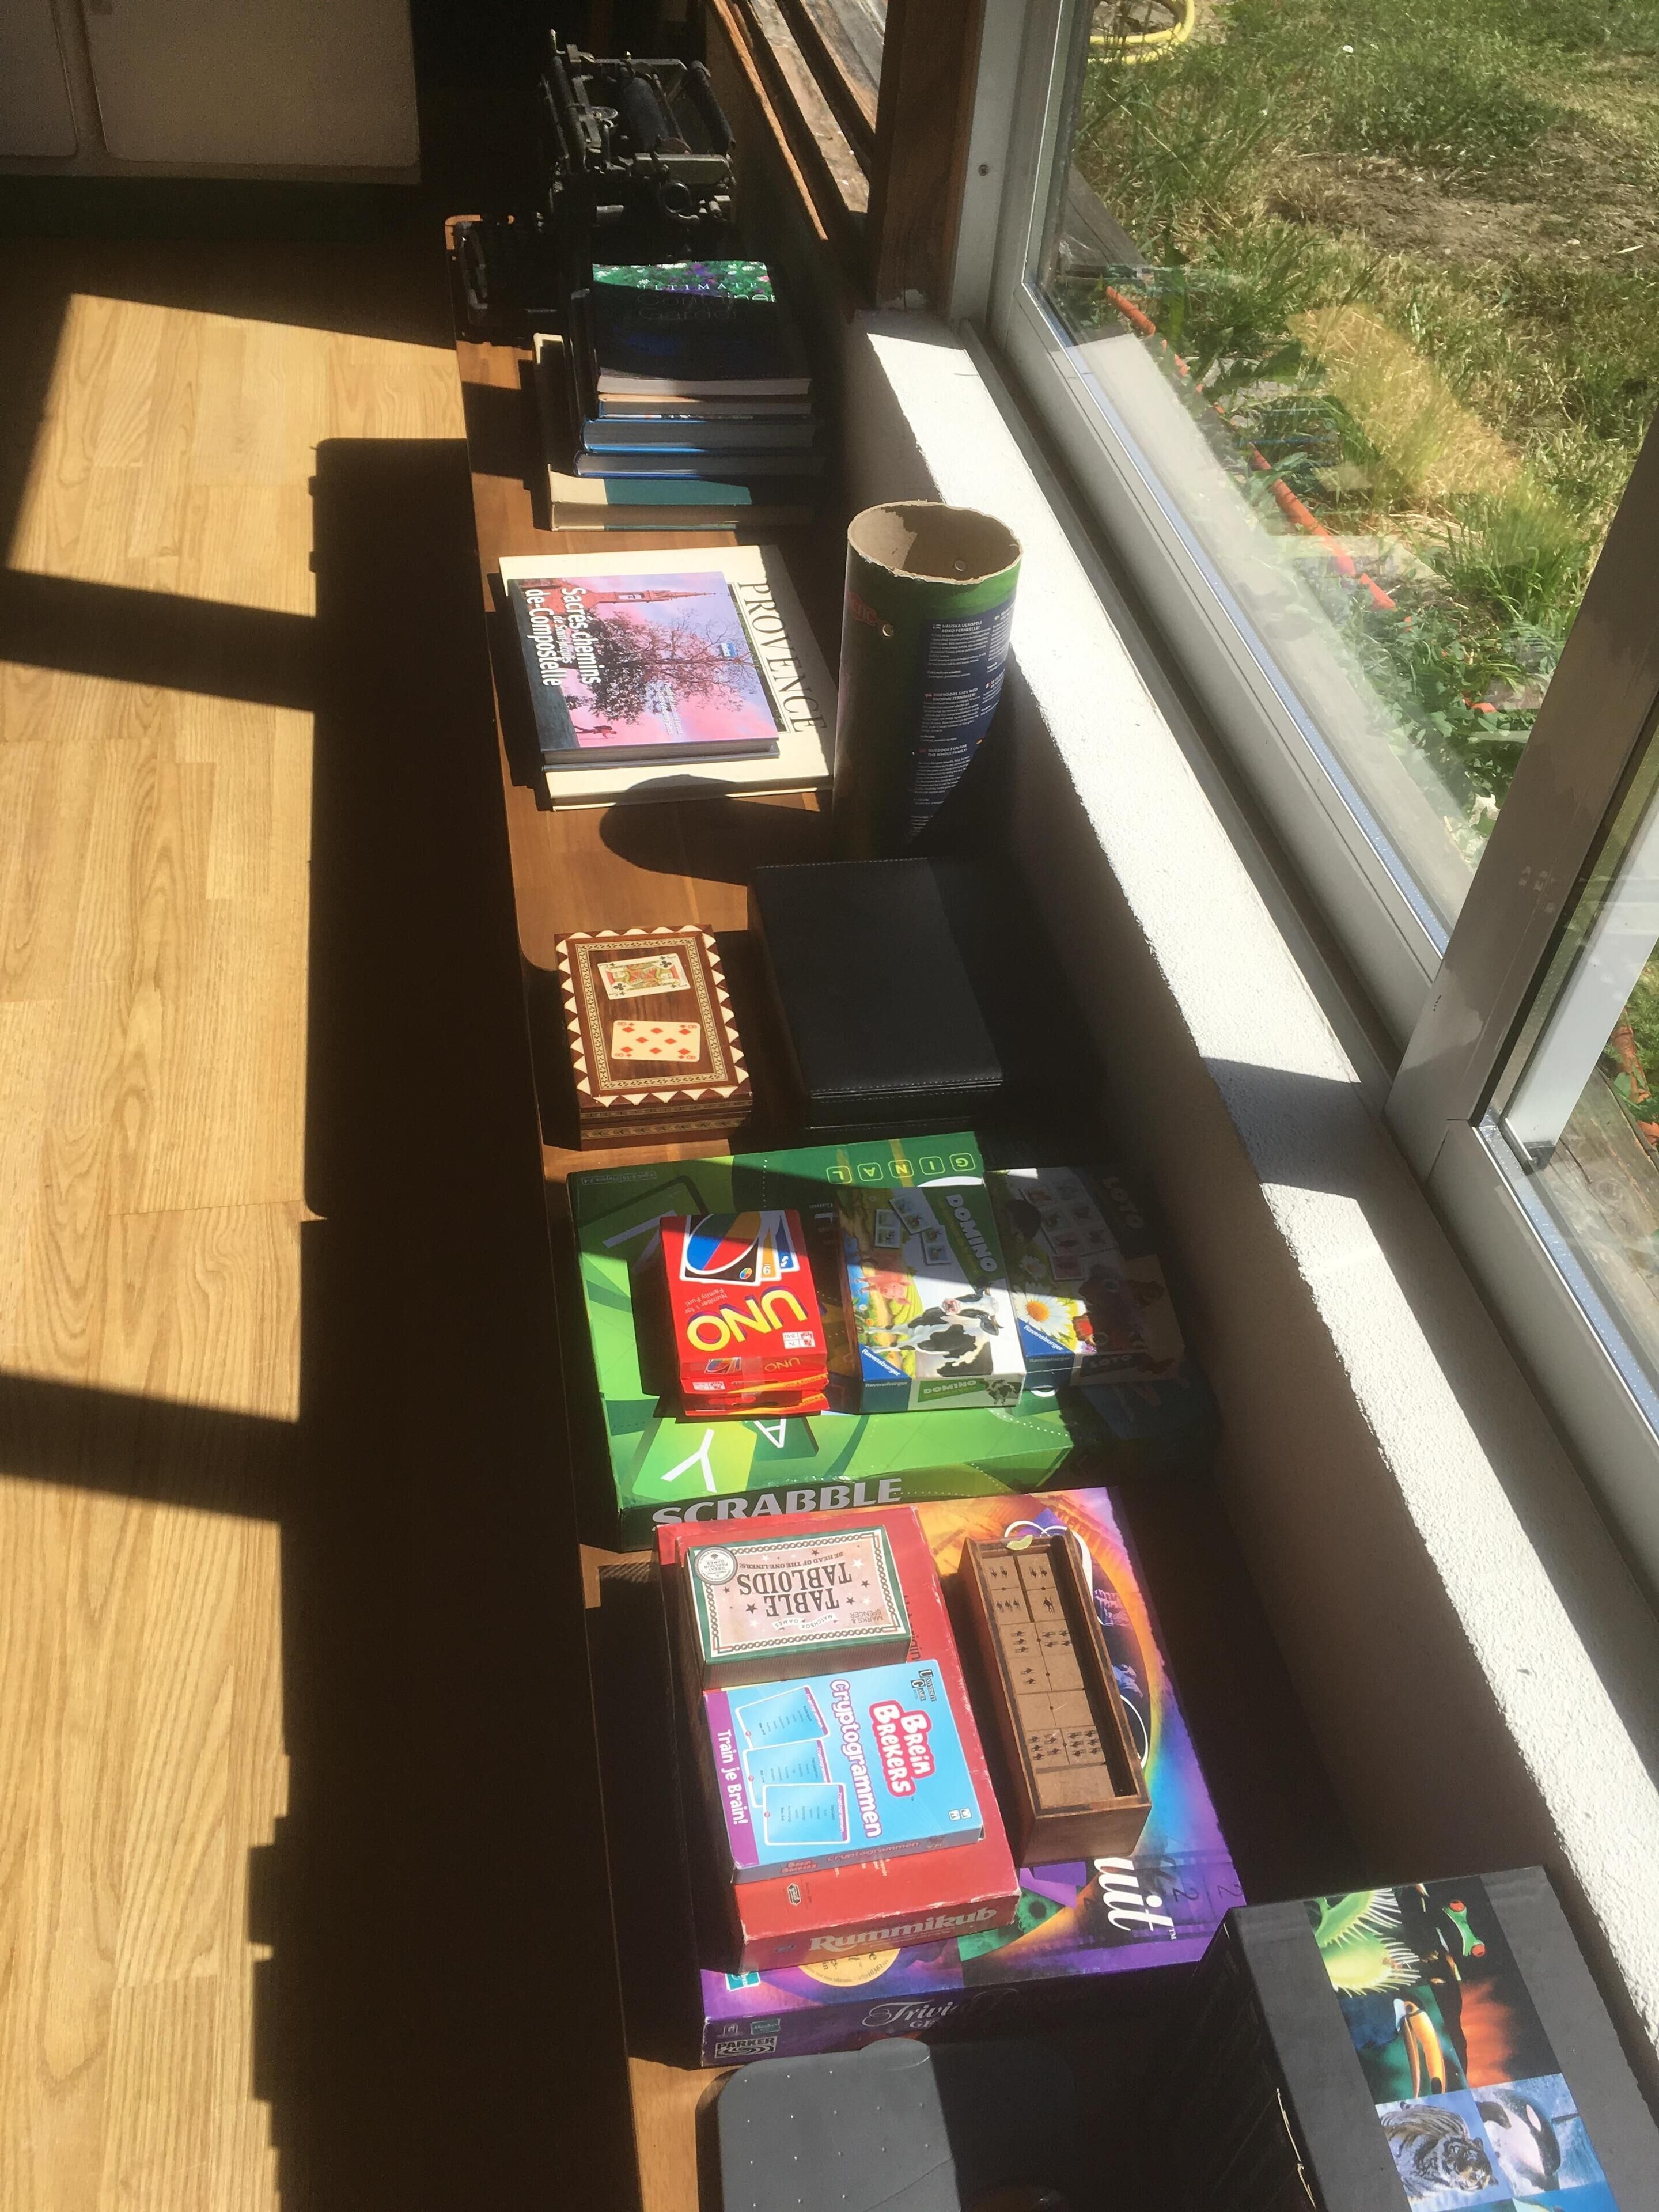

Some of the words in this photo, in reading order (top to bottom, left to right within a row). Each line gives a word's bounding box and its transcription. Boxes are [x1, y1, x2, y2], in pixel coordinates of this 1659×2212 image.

[561, 587, 594, 630] Sacrés
[524, 588, 569, 687] de-Compostelle
[571, 631, 605, 685] chemins
[737, 581, 828, 733] PROVENCE
[945, 1194, 998, 1272] DOMINO
[685, 1296, 701, 1306] Fun!
[701, 1287, 725, 1301] Family
[701, 1293, 728, 1308] Number
[687, 1285, 809, 1352] UNO
[1024, 1324, 1065, 1351] Ravensburger
[764, 1357, 801, 1372] UNO
[861, 1348, 902, 1377] Ravensburger
[923, 1380, 977, 1395] DOMINO
[652, 1478, 902, 1525] SCRABBLE
[813, 1554, 833, 1563] HEAD
[834, 1551, 843, 1559] BE
[737, 1562, 852, 1596] TABLOIDS
[763, 1587, 840, 1617] TABLE
[849, 1609, 882, 1619] SPENCER
[774, 1618, 799, 1628] GAMES
[801, 1613, 833, 1630] MATCHBOX
[856, 1615, 884, 1624] MARKS
[717, 1729, 737, 1763] Train
[831, 1679, 883, 1838] Cryptogrammen
[721, 1767, 741, 1781] je
[725, 1785, 747, 1825] Brain!
[809, 1906, 998, 1952] Rummikub
[717, 2037, 775, 2049] PARKER
